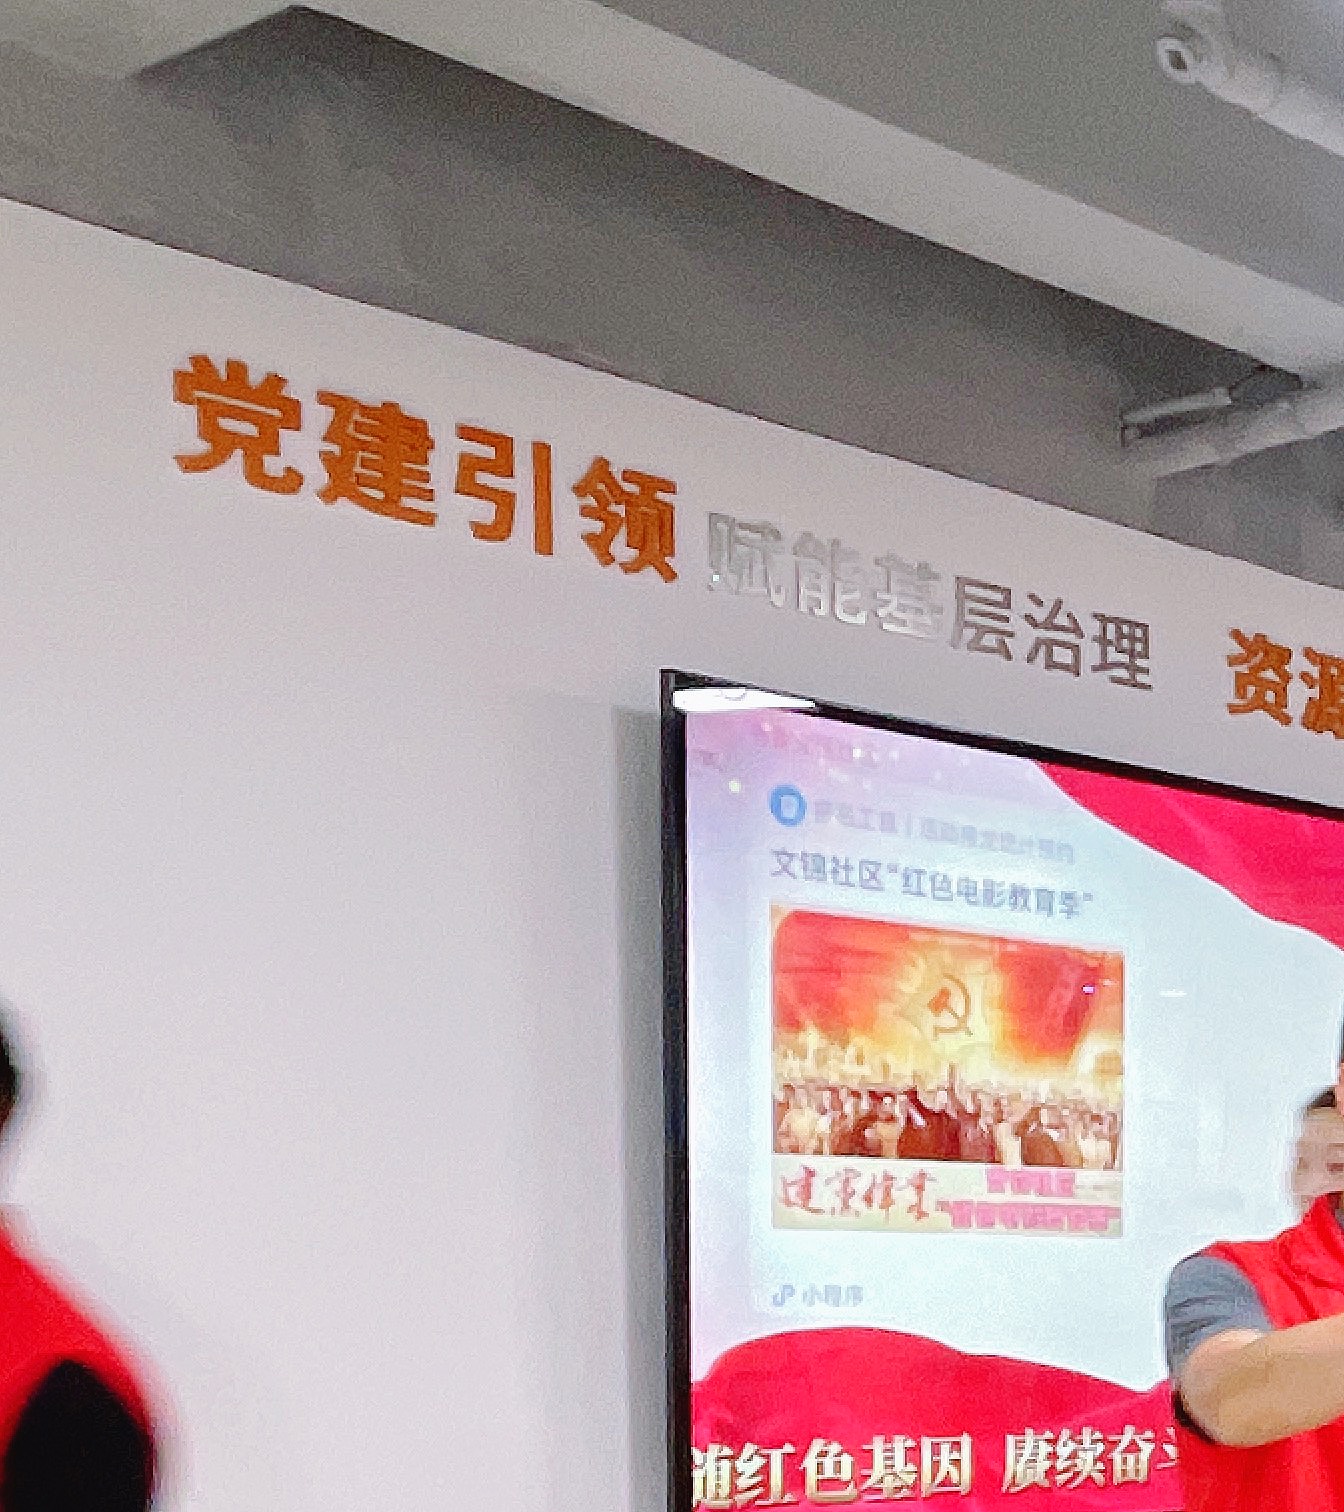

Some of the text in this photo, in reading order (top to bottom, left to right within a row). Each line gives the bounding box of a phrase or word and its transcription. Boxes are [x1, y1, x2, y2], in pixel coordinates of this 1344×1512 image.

[172, 353, 679, 583] 党建引领
[707, 510, 1154, 691] 赋能基层治理
